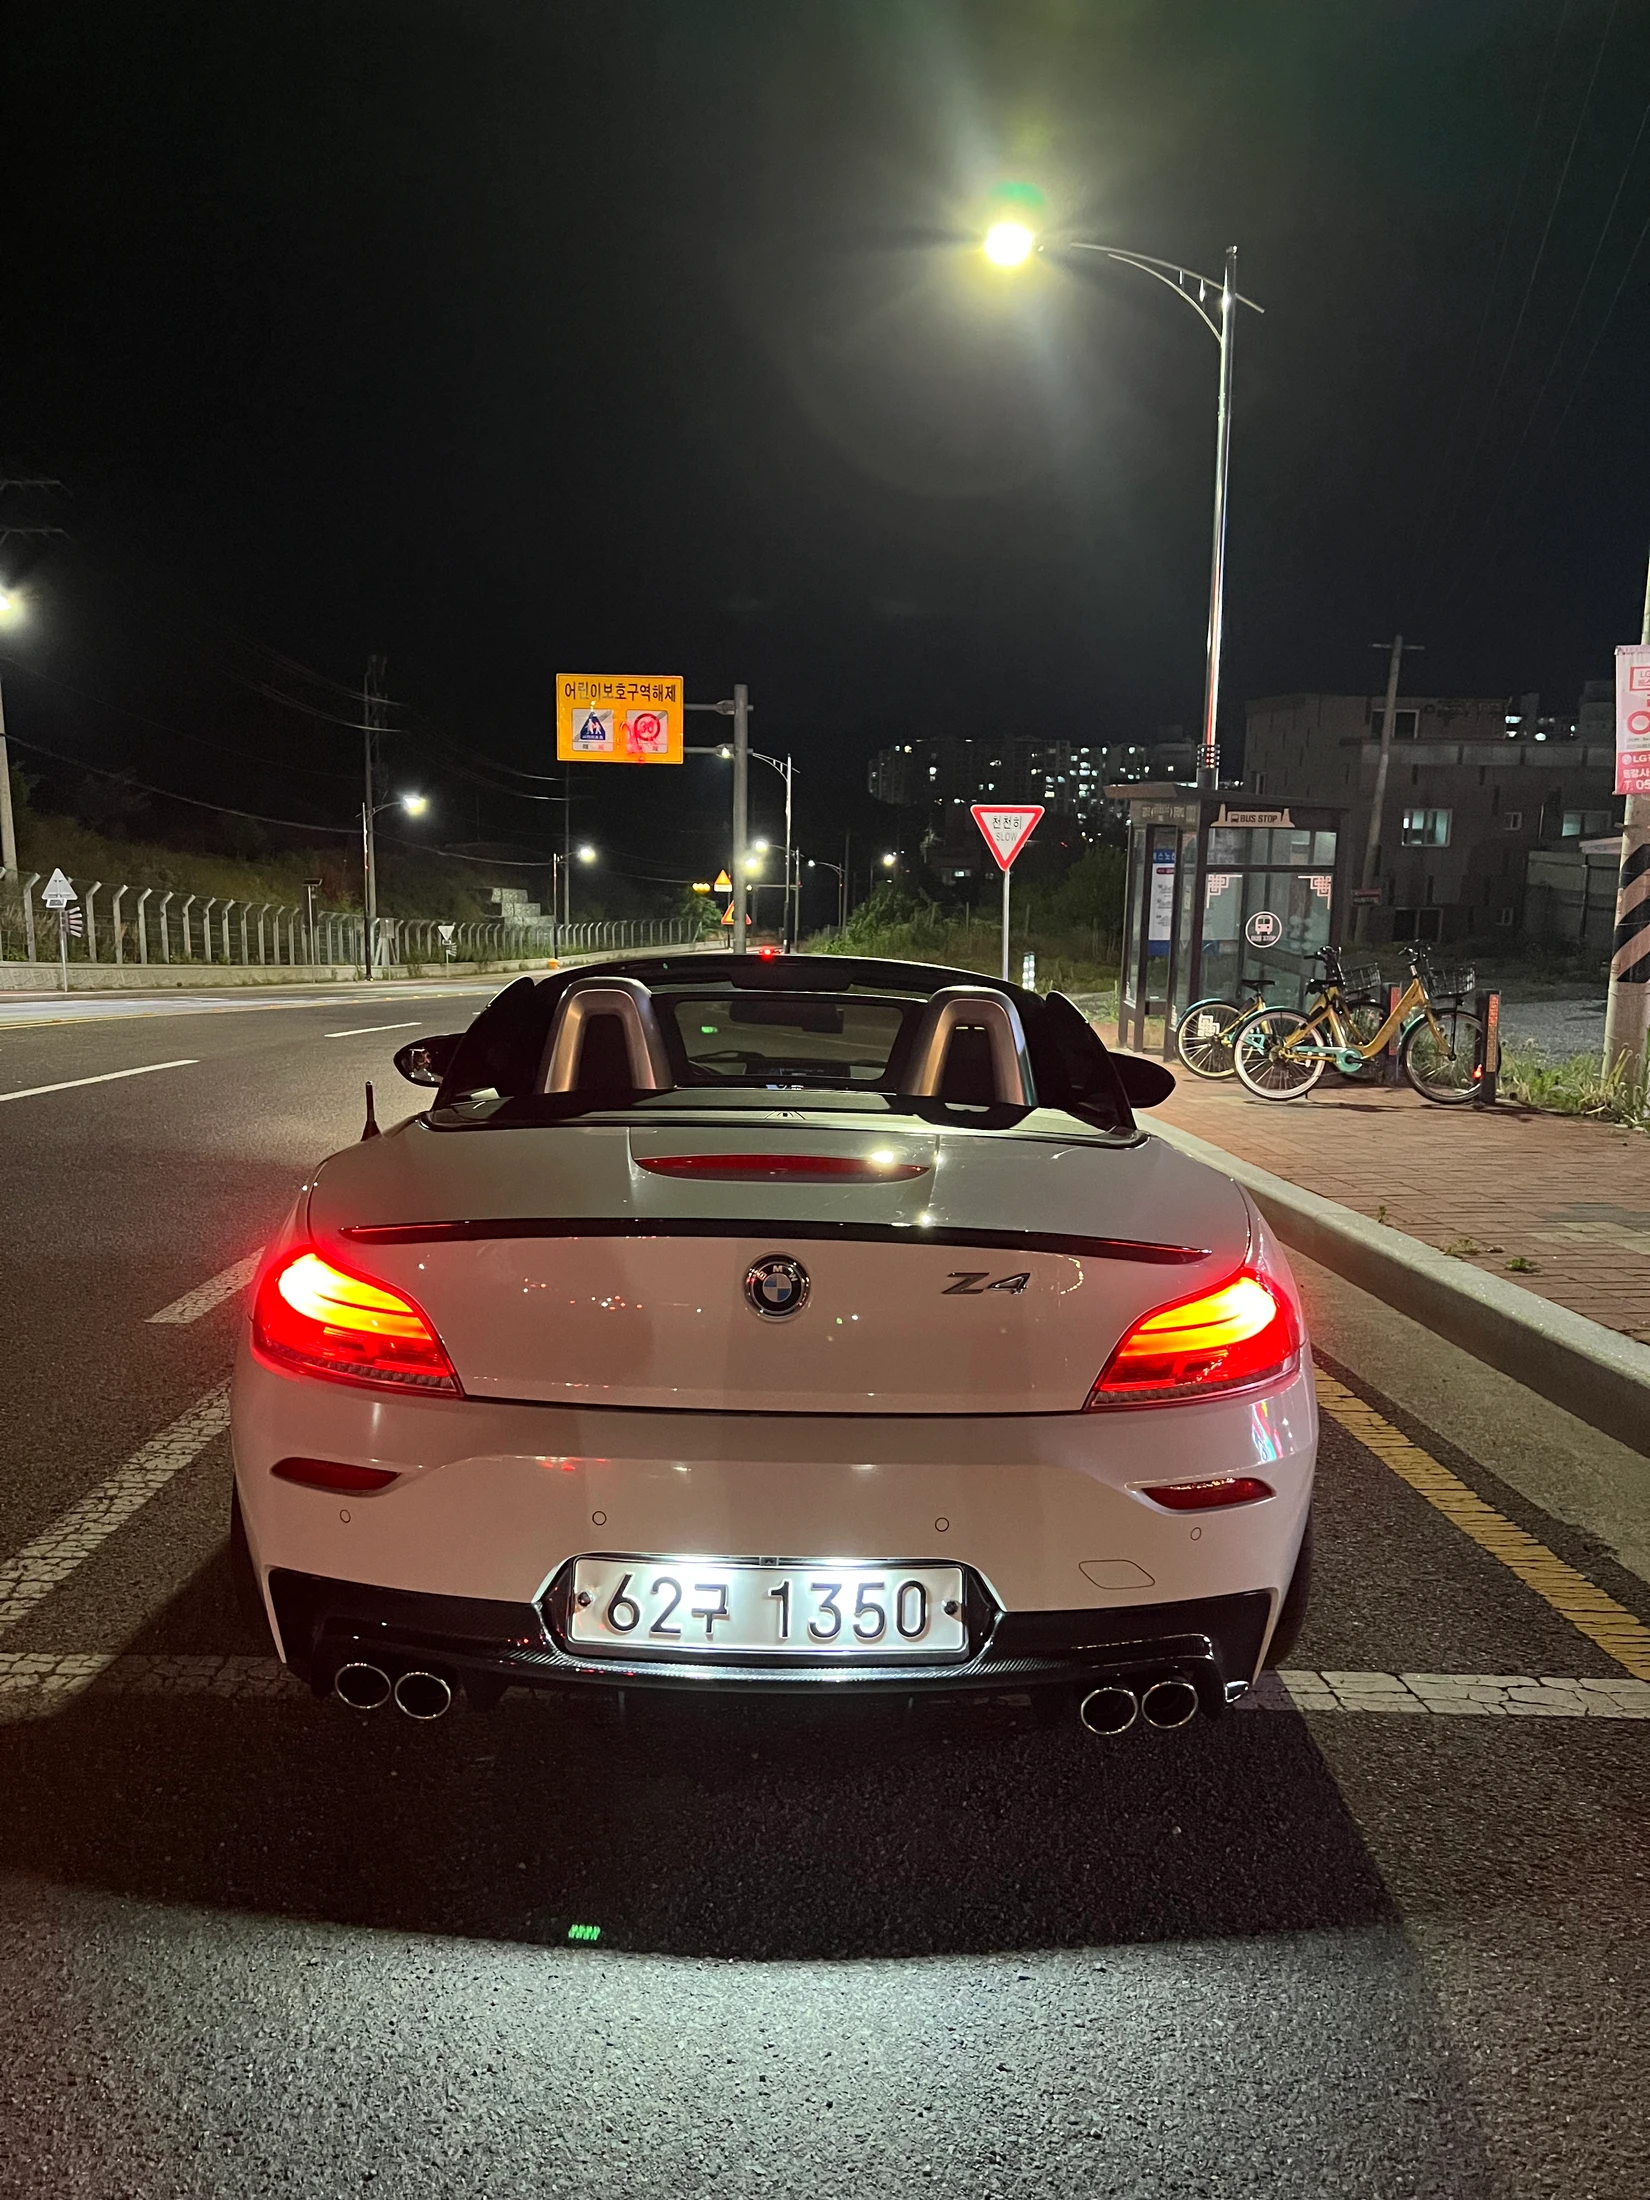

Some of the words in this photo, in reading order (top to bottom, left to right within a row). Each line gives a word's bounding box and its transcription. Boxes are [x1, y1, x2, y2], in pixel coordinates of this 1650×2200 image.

[564, 682, 676, 702] 어린이보호구역해제
[993, 816, 1022, 829] 천천히
[1240, 814, 1256, 823] BUS
[1258, 814, 1278, 823] STOP
[996, 832, 1017, 841] SLOW
[757, 1264, 798, 1281] BMW
[941, 1272, 1030, 1294] Z4
[606, 1571, 730, 1636] 62구
[768, 1579, 928, 1639] 1350
